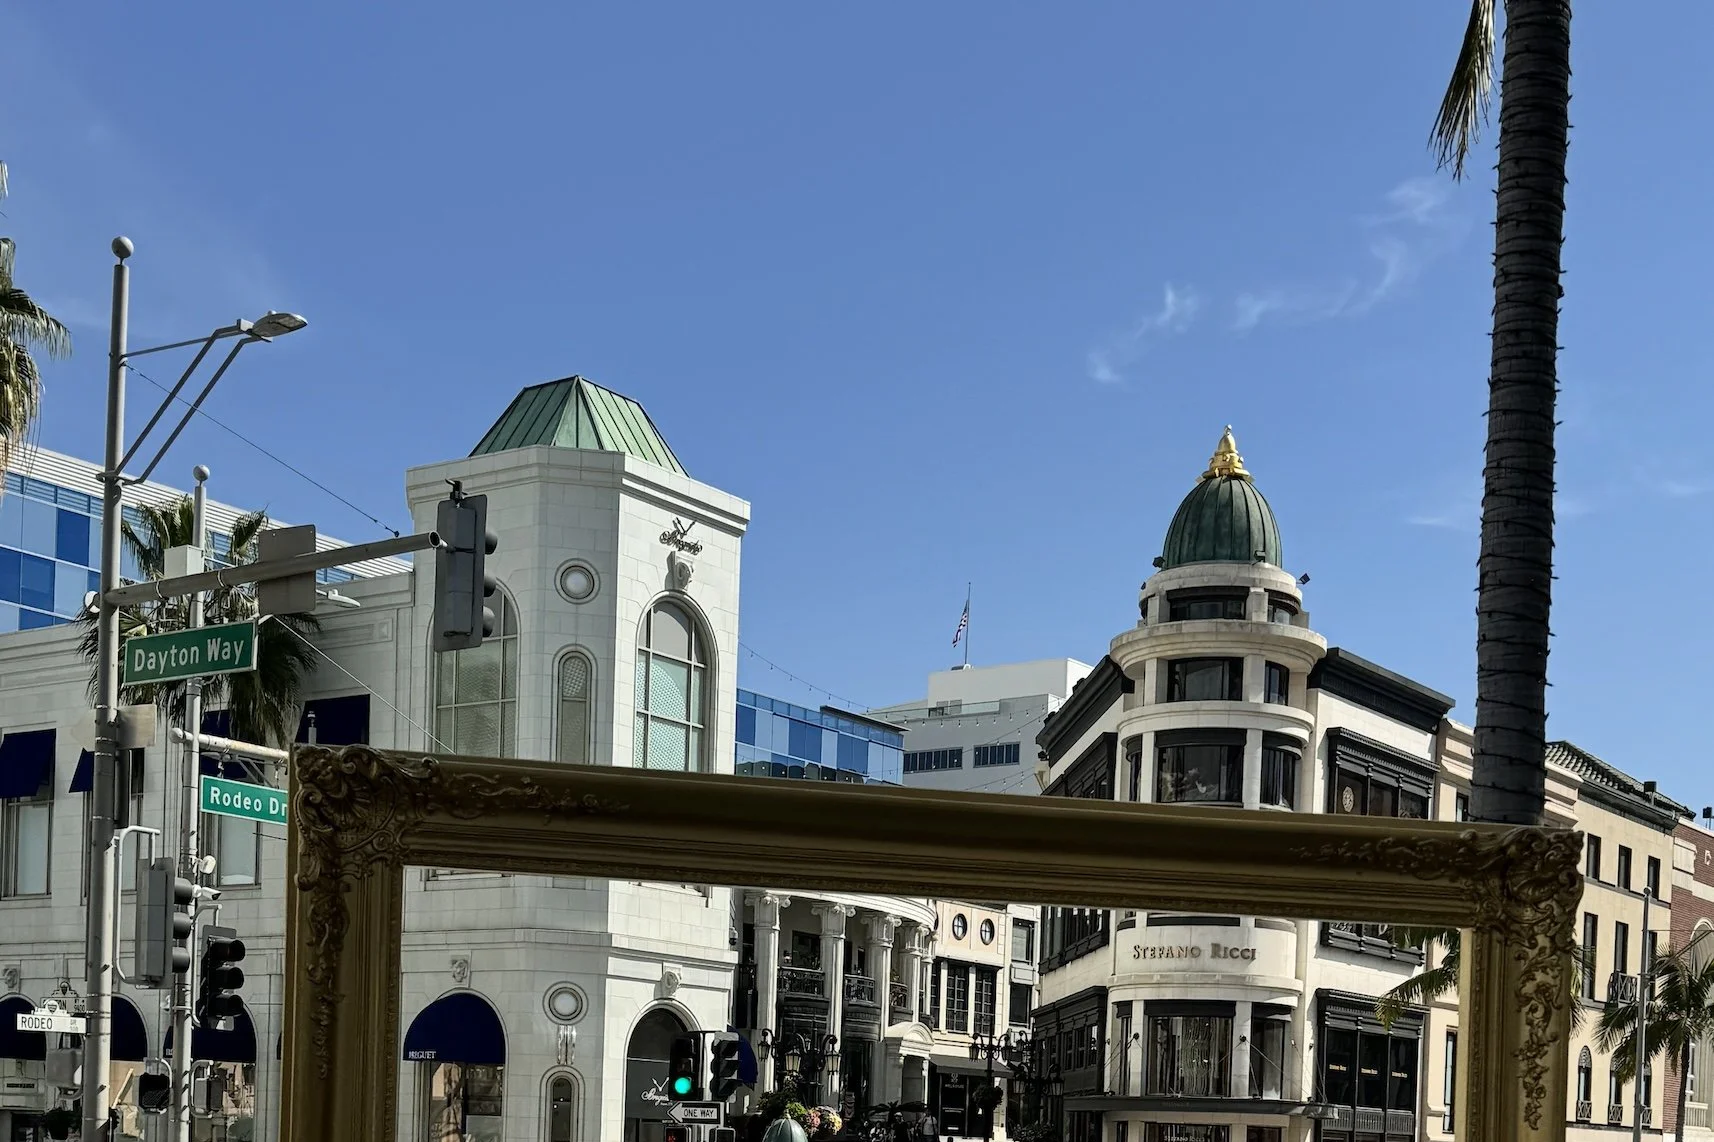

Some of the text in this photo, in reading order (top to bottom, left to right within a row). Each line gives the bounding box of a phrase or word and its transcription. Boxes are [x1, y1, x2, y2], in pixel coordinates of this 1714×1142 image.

[133, 637, 244, 674] Dayton Way
[210, 786, 287, 816] Rodeo Dr
[1133, 943, 1257, 960] STEFANO RICCI
[21, 1016, 53, 1030] RODEO
[683, 1108, 715, 1118] ONE WAY
